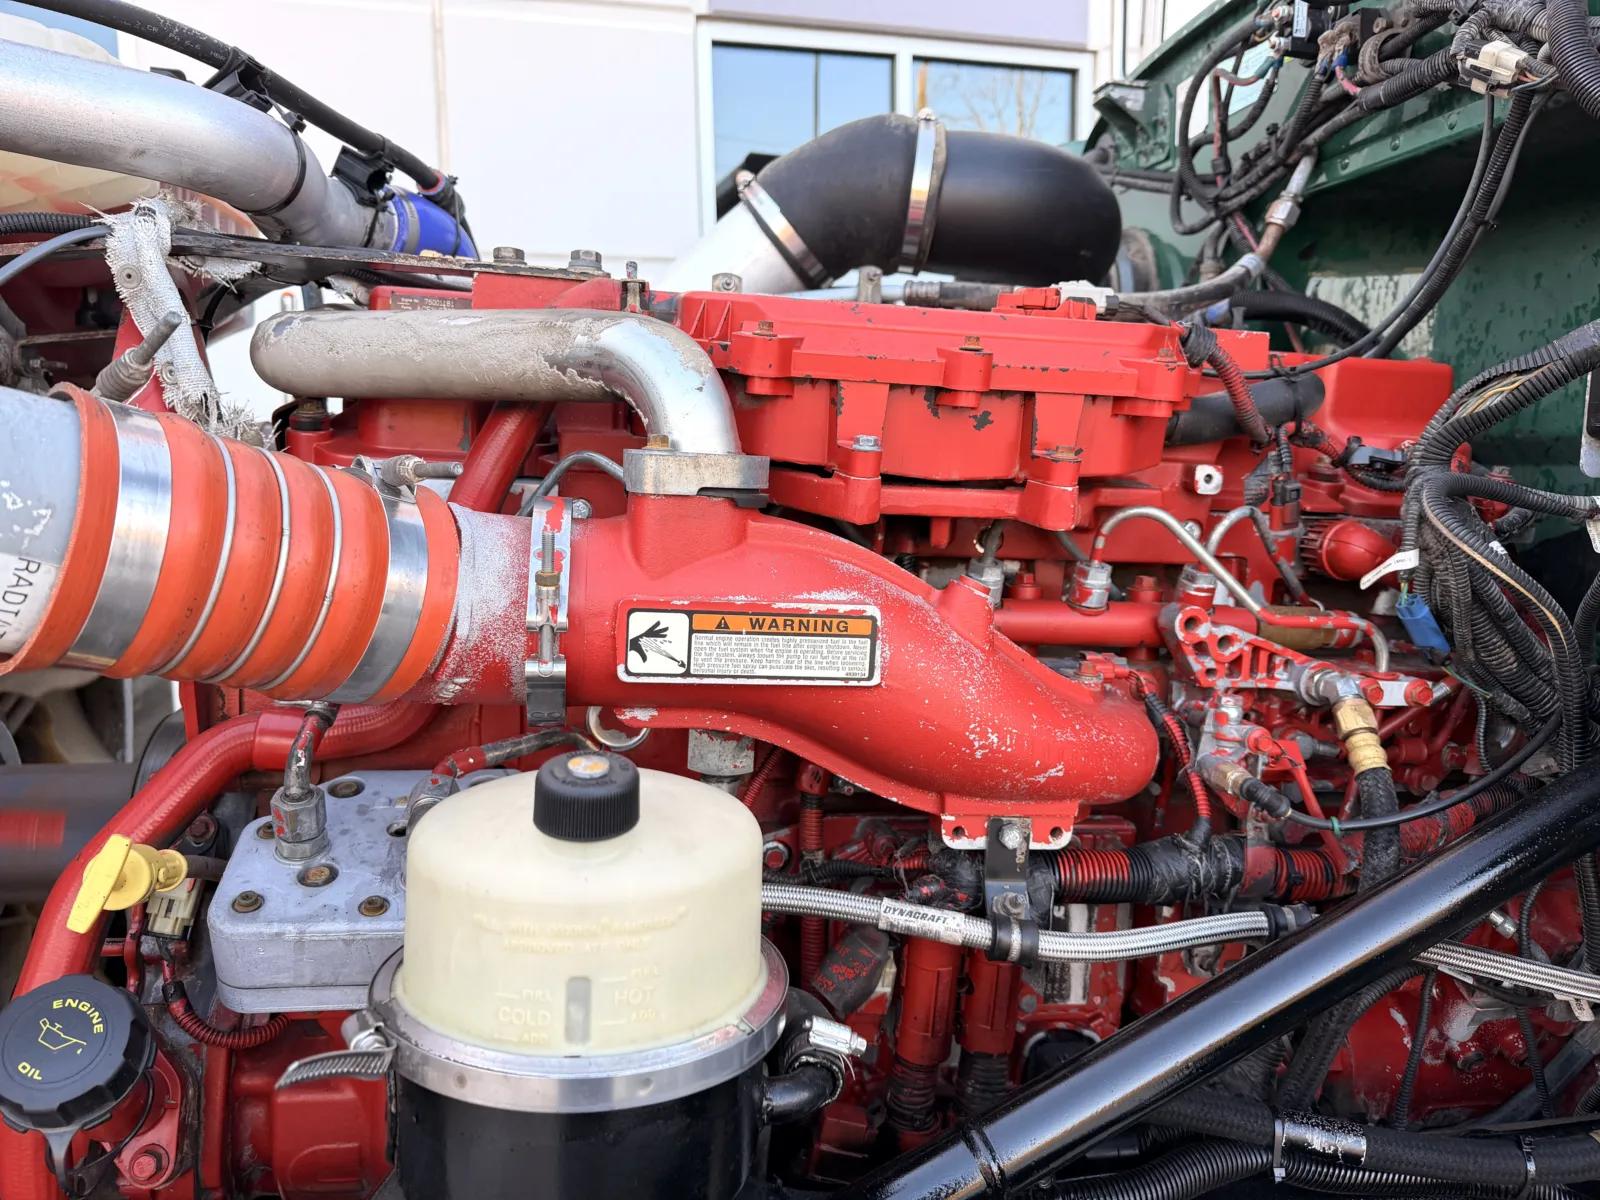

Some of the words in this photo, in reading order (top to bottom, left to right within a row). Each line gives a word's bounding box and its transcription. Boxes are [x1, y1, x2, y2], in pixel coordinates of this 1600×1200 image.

[749, 617, 850, 633] WARNING
[614, 985, 656, 1008] HOT
[52, 998, 104, 1035] ENGINE
[498, 1005, 552, 1025] COLD
[17, 1061, 43, 1081] OIL
